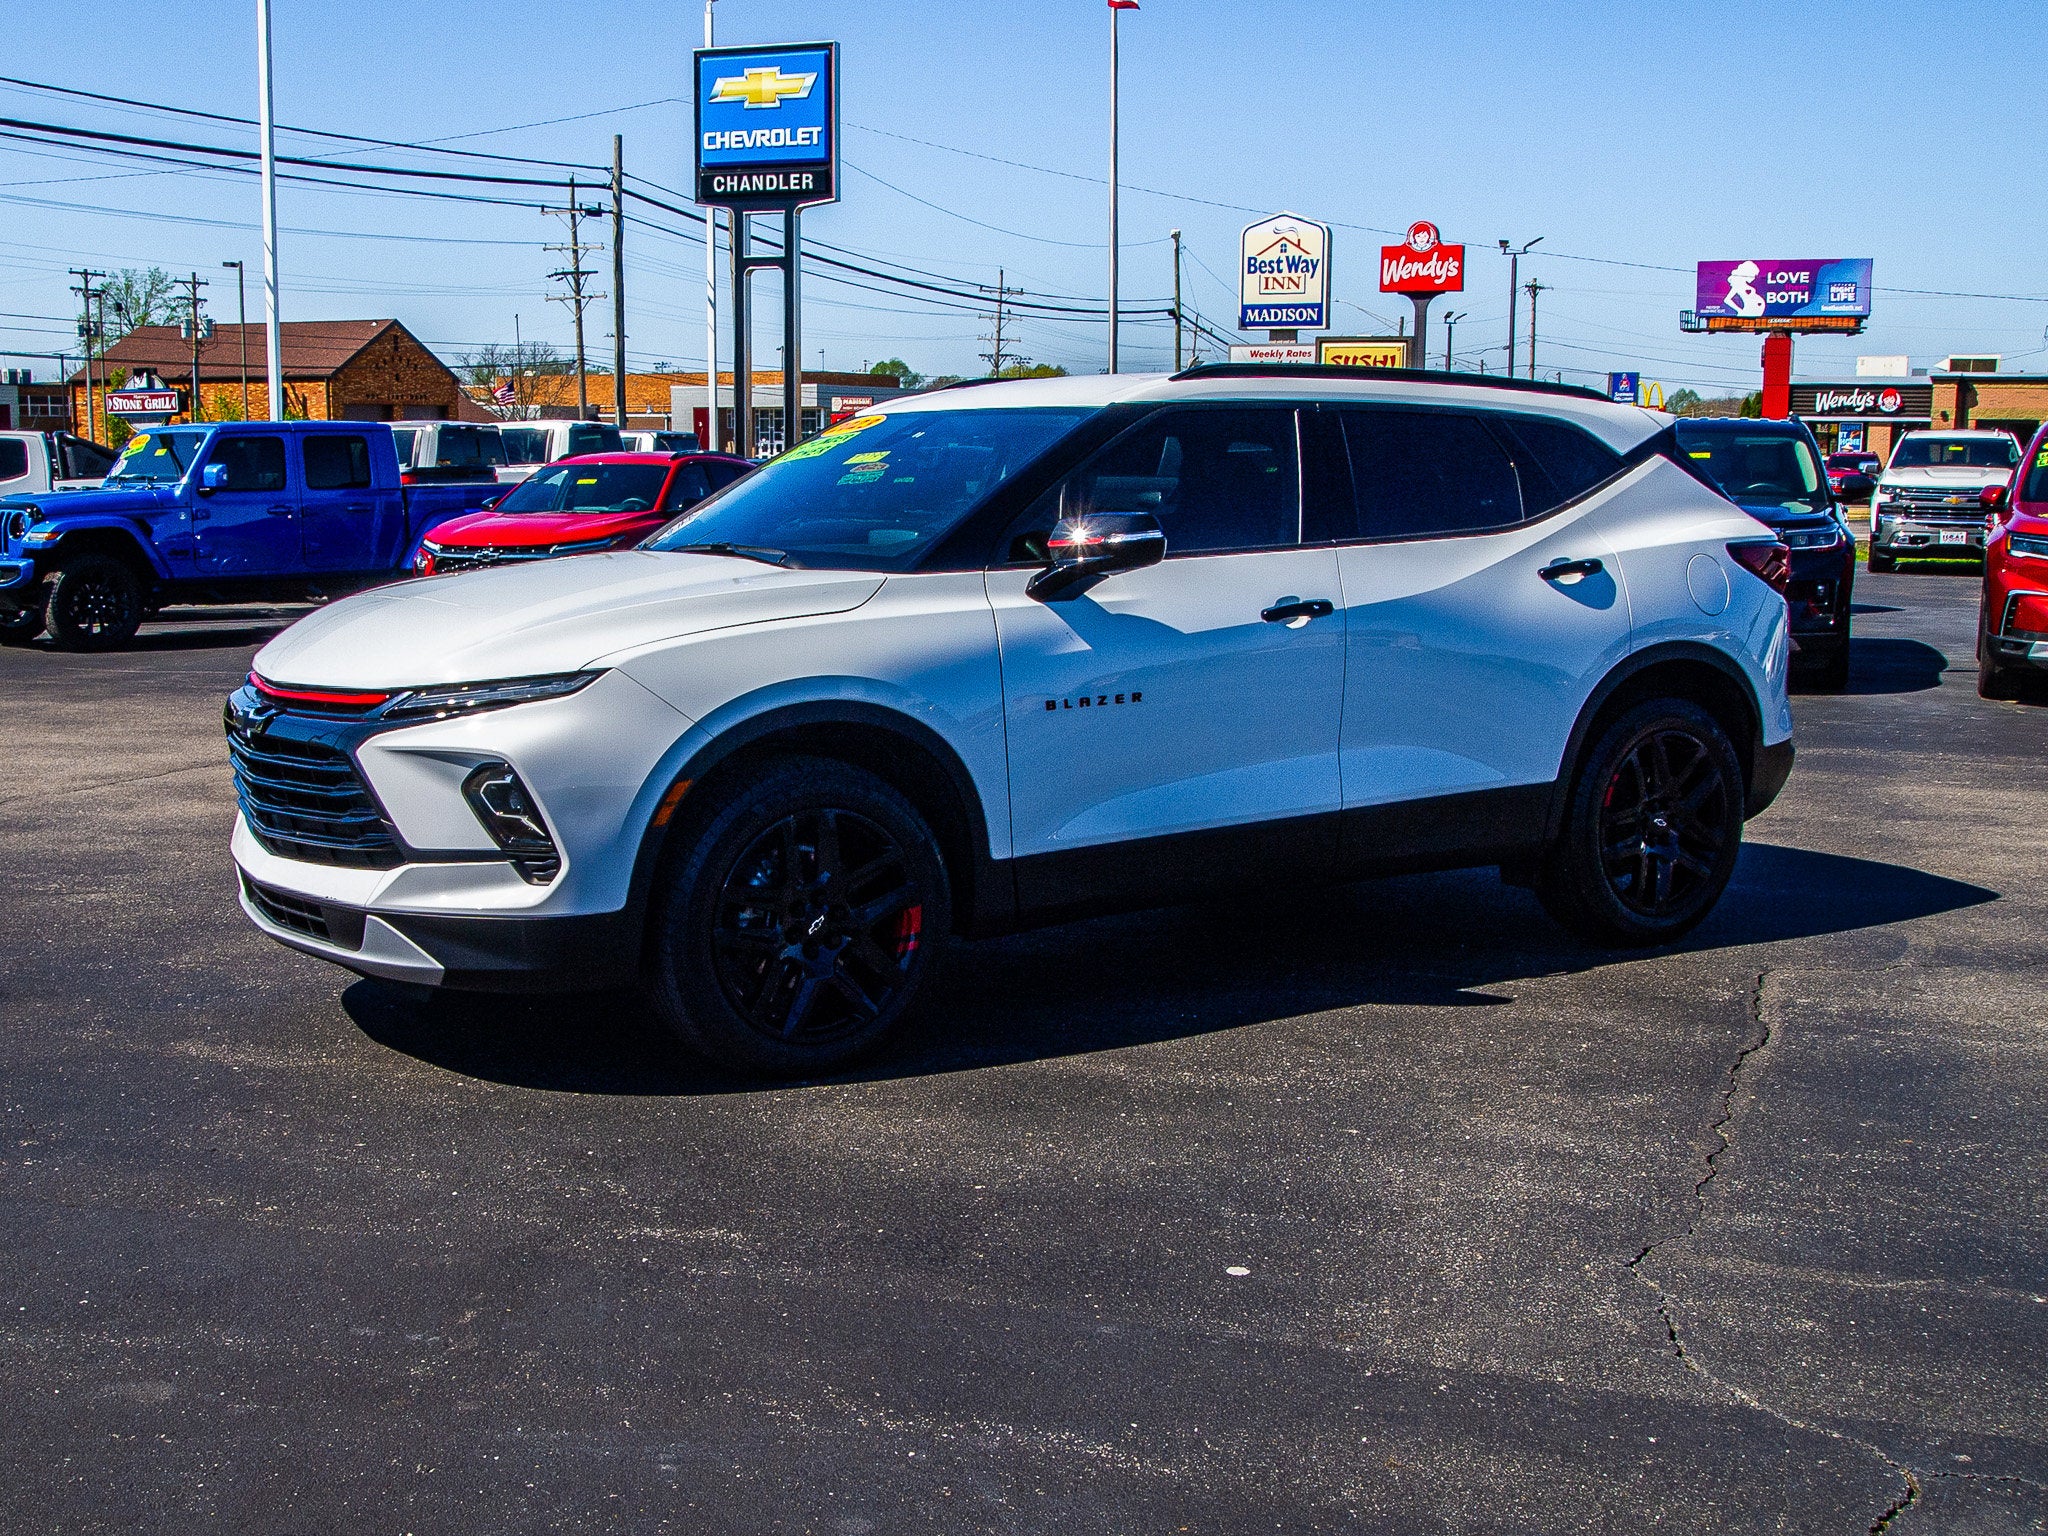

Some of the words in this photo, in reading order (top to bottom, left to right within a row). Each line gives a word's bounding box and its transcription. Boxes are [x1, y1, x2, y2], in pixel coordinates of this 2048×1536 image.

[704, 127, 822, 150] CHEVROLET
[713, 174, 813, 192] CHANDLER
[1247, 256, 1284, 274] Best
[1285, 255, 1320, 279] Way
[1382, 252, 1459, 286] Wendy's
[1263, 276, 1301, 290] INN
[1767, 271, 1810, 284] LOVE
[1766, 291, 1809, 304] BOTH
[1830, 292, 1855, 302] LIFE
[1245, 308, 1318, 322] MADISON
[1249, 350, 1284, 359] Weekly
[1286, 350, 1312, 358] Rates
[112, 397, 143, 410] STONE
[144, 396, 172, 410] GRILL
[1815, 388, 1875, 412] Wendy's
[1045, 692, 1142, 711] BLAZER
